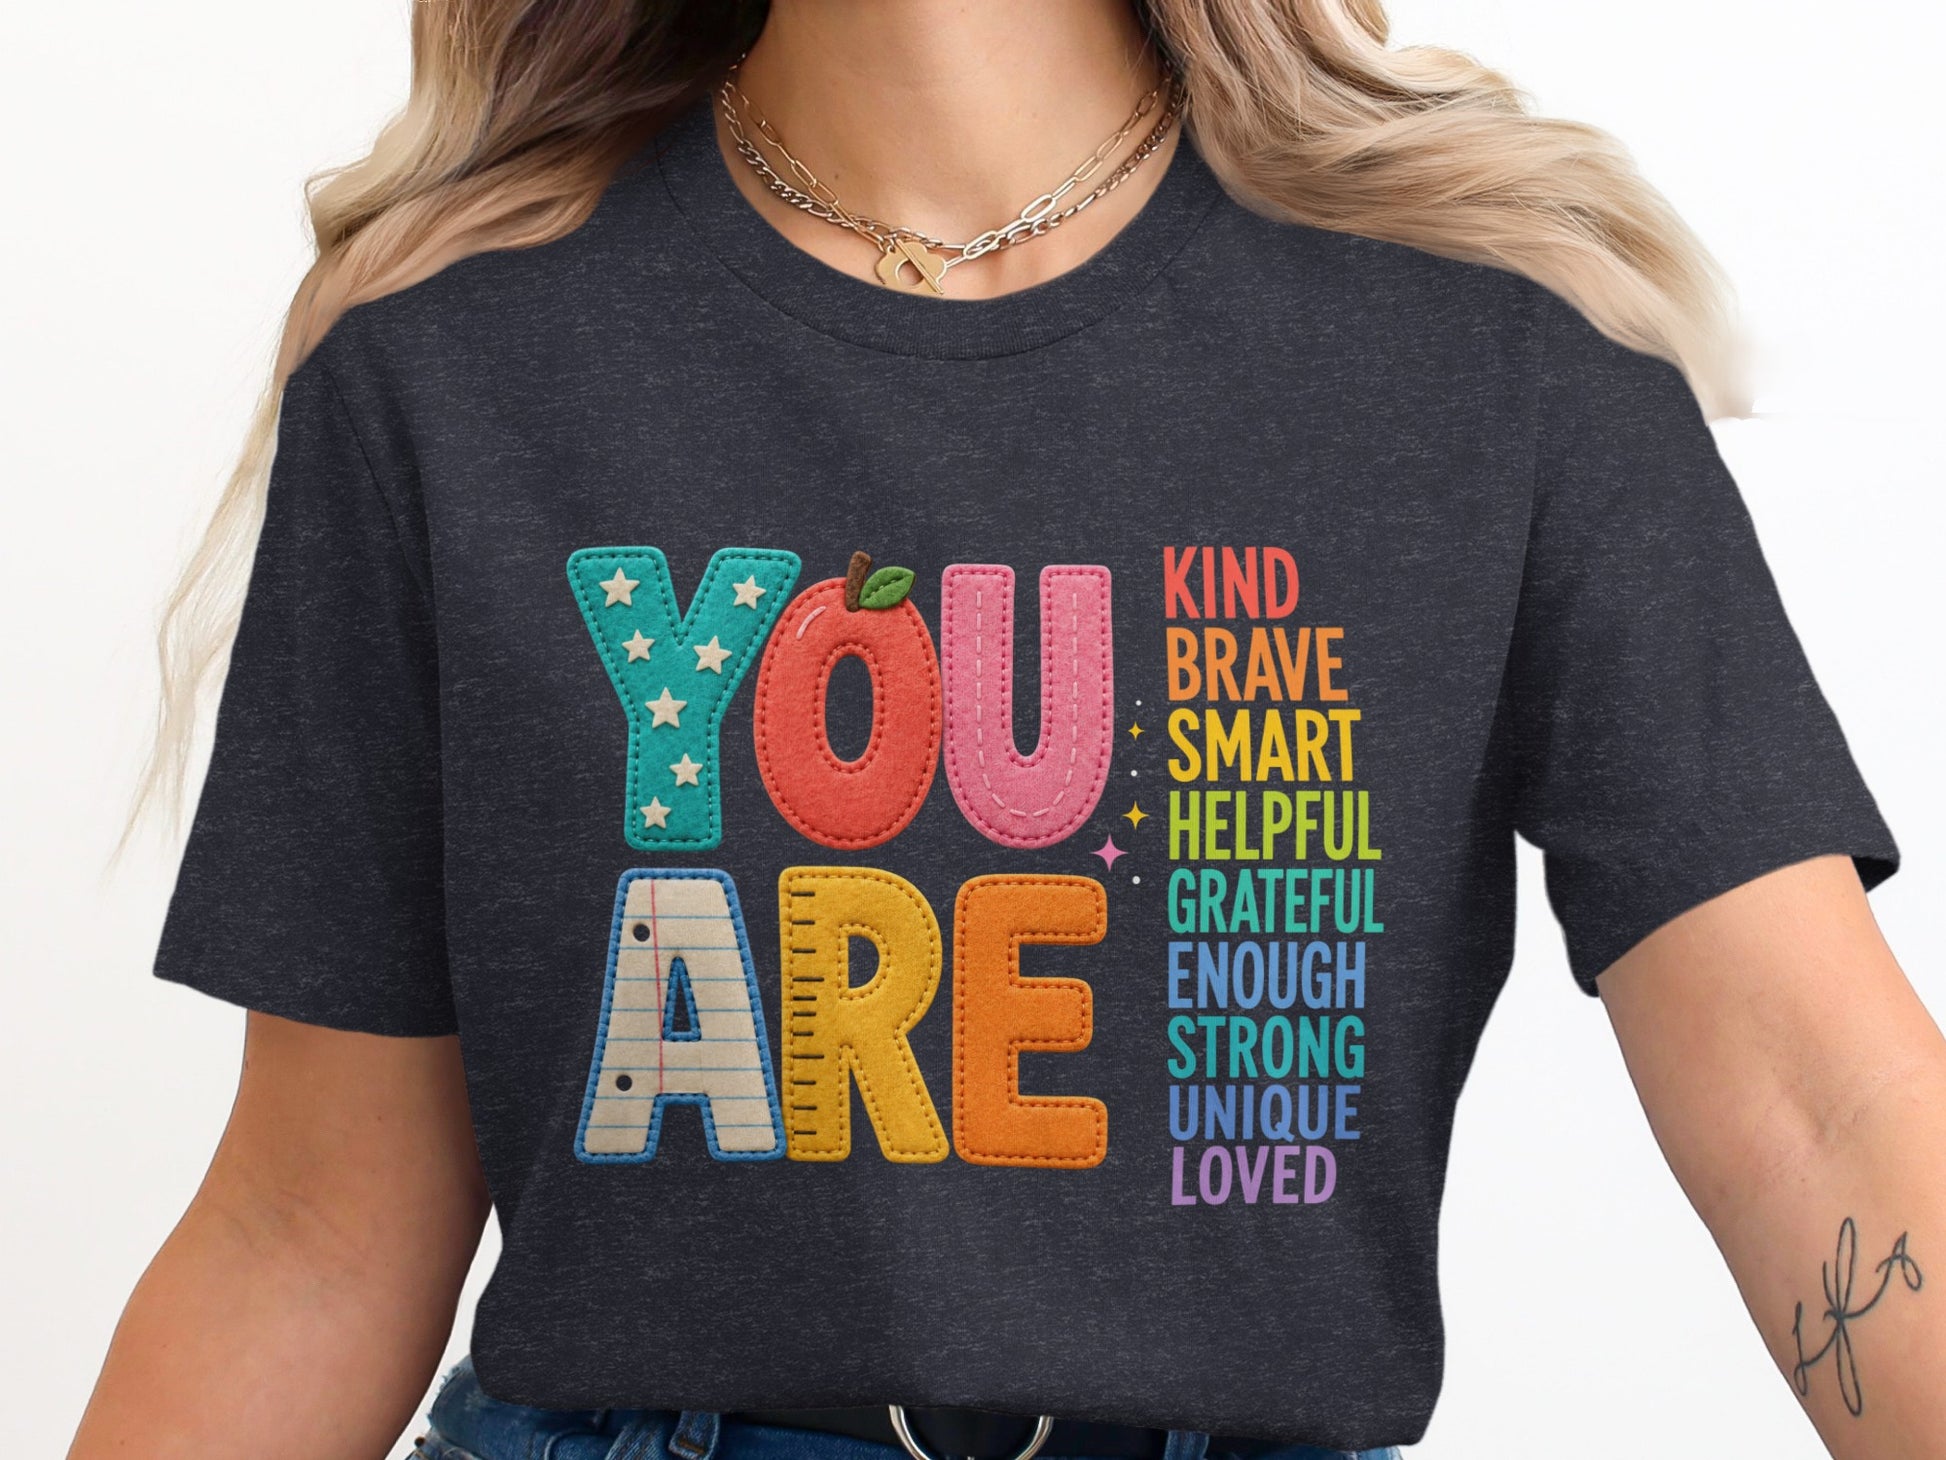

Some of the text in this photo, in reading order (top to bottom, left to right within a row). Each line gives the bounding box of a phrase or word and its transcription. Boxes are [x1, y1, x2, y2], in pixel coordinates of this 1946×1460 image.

[1164, 546, 1299, 619] KIND
[566, 545, 1114, 850] YOU
[1166, 627, 1348, 701] BRAVE
[1168, 708, 1362, 782] SMART
[1169, 790, 1382, 860] HELPFUL
[1168, 868, 1384, 933] GRATEFUL
[1168, 941, 1365, 1009] ENOUGH
[574, 866, 1108, 1169] ARE
[1168, 1015, 1365, 1079] STRONG
[1169, 1084, 1360, 1141] UNIQUE
[1171, 1146, 1337, 1206] LOVED
